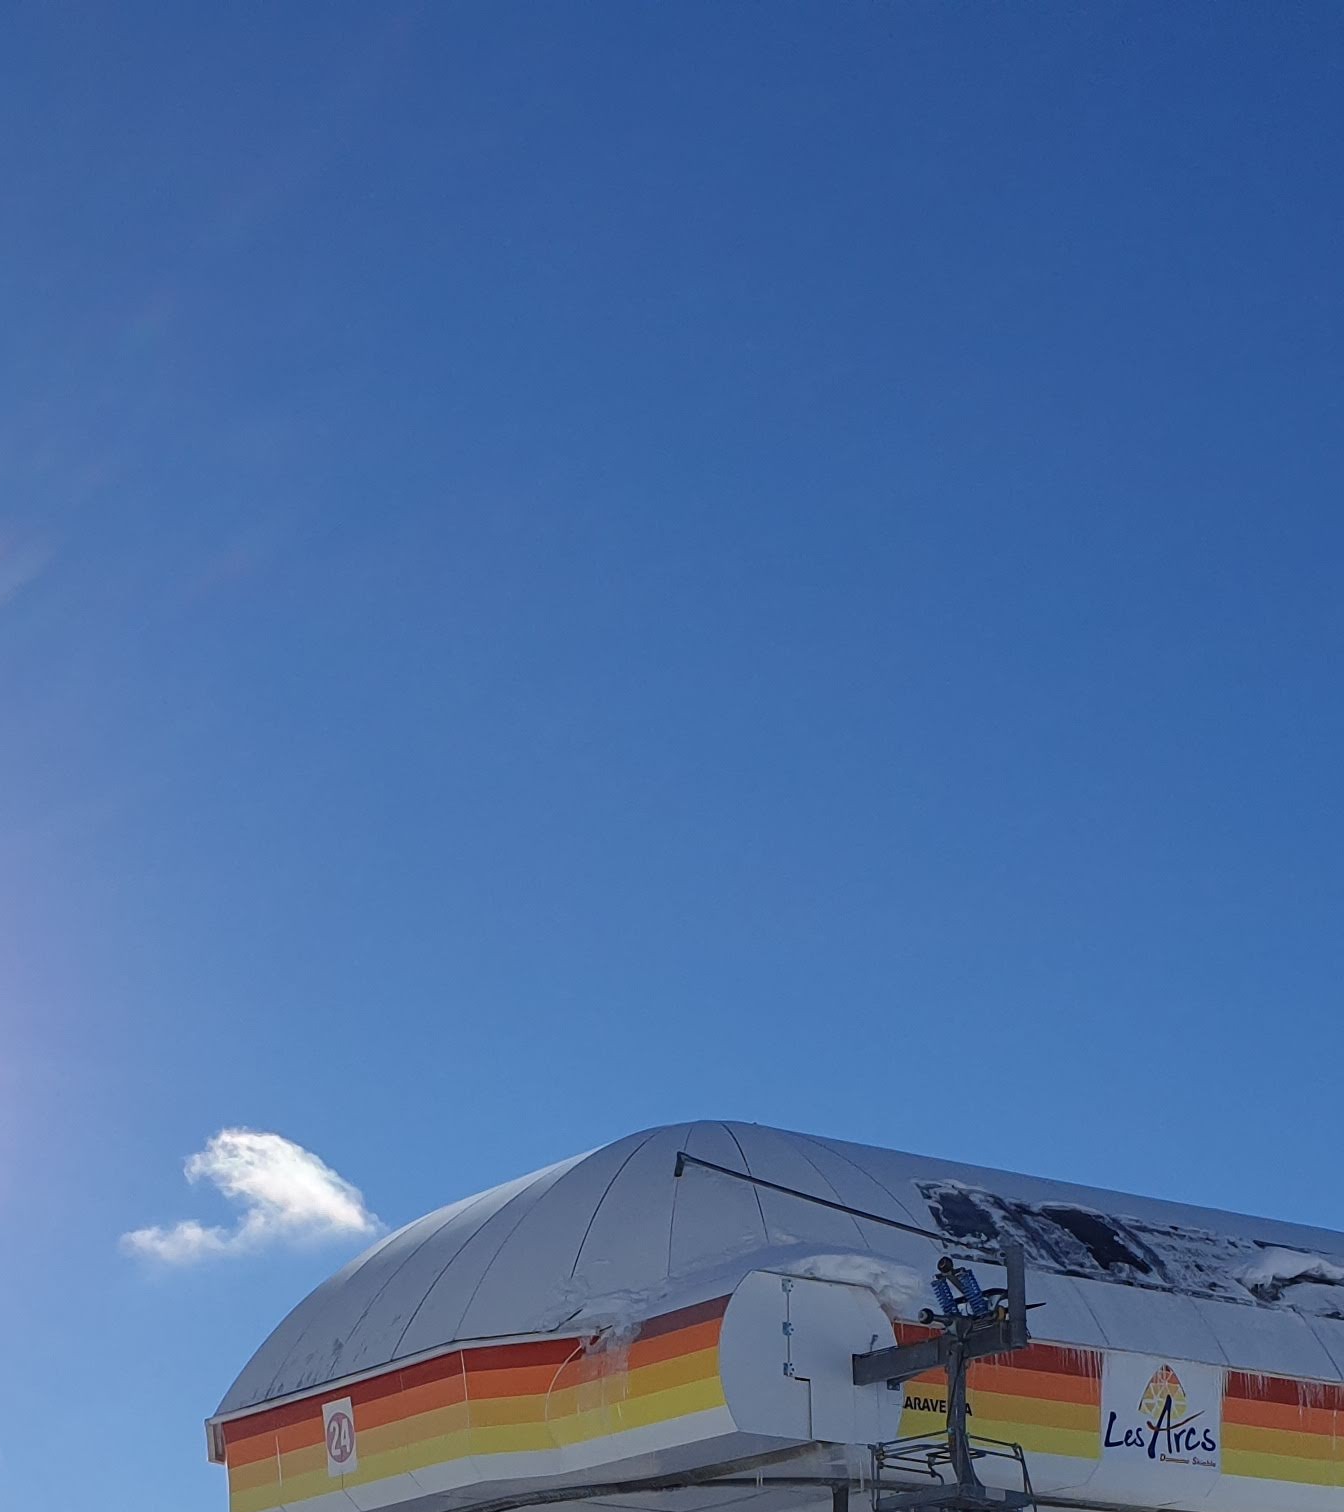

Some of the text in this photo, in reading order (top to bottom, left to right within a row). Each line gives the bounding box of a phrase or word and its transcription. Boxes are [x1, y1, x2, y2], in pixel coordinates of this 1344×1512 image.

[329, 1418, 351, 1457] 24
[1104, 1394, 1217, 1459] Les Arcs
